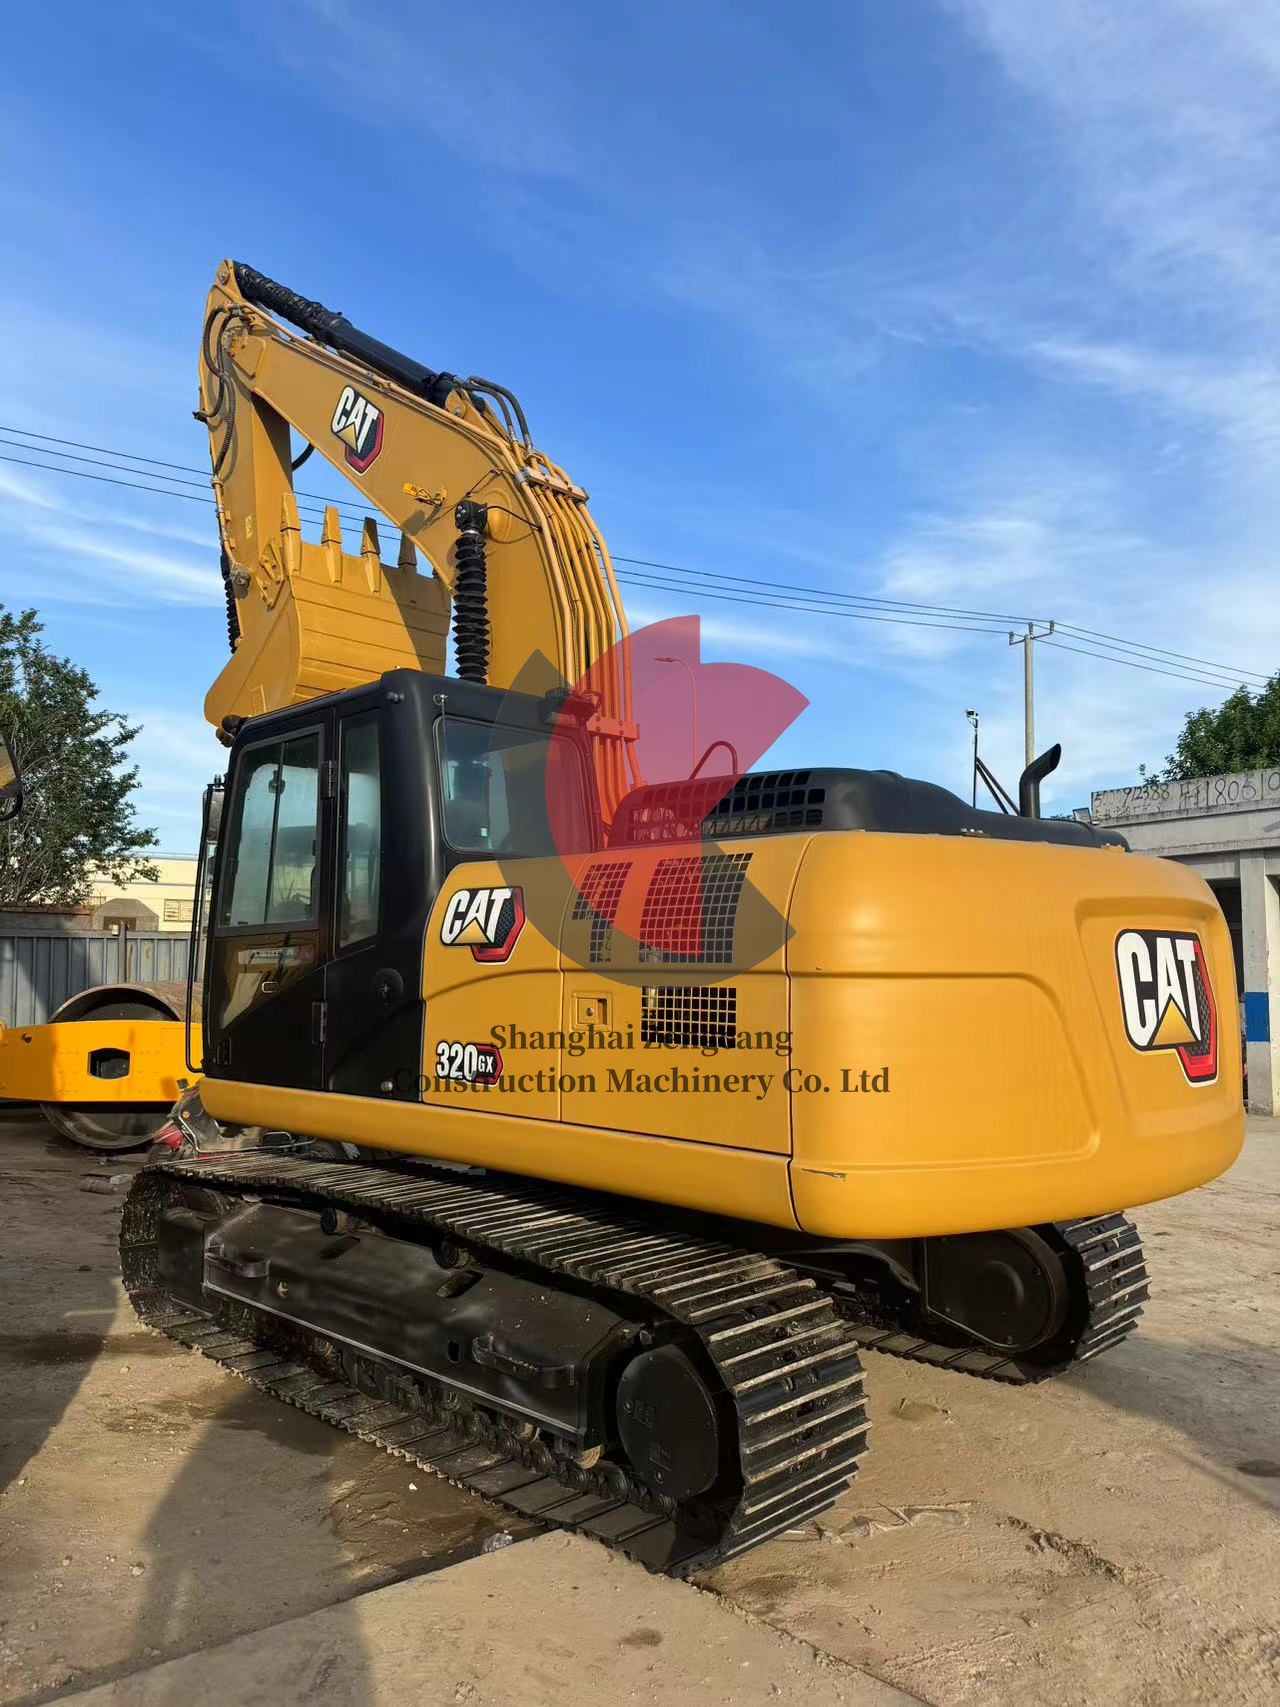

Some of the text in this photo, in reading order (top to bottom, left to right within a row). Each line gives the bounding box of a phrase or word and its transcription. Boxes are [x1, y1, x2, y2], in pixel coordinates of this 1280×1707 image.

[332, 386, 379, 453] CAT
[441, 888, 513, 944] CAT
[1117, 932, 1201, 1047] CAT
